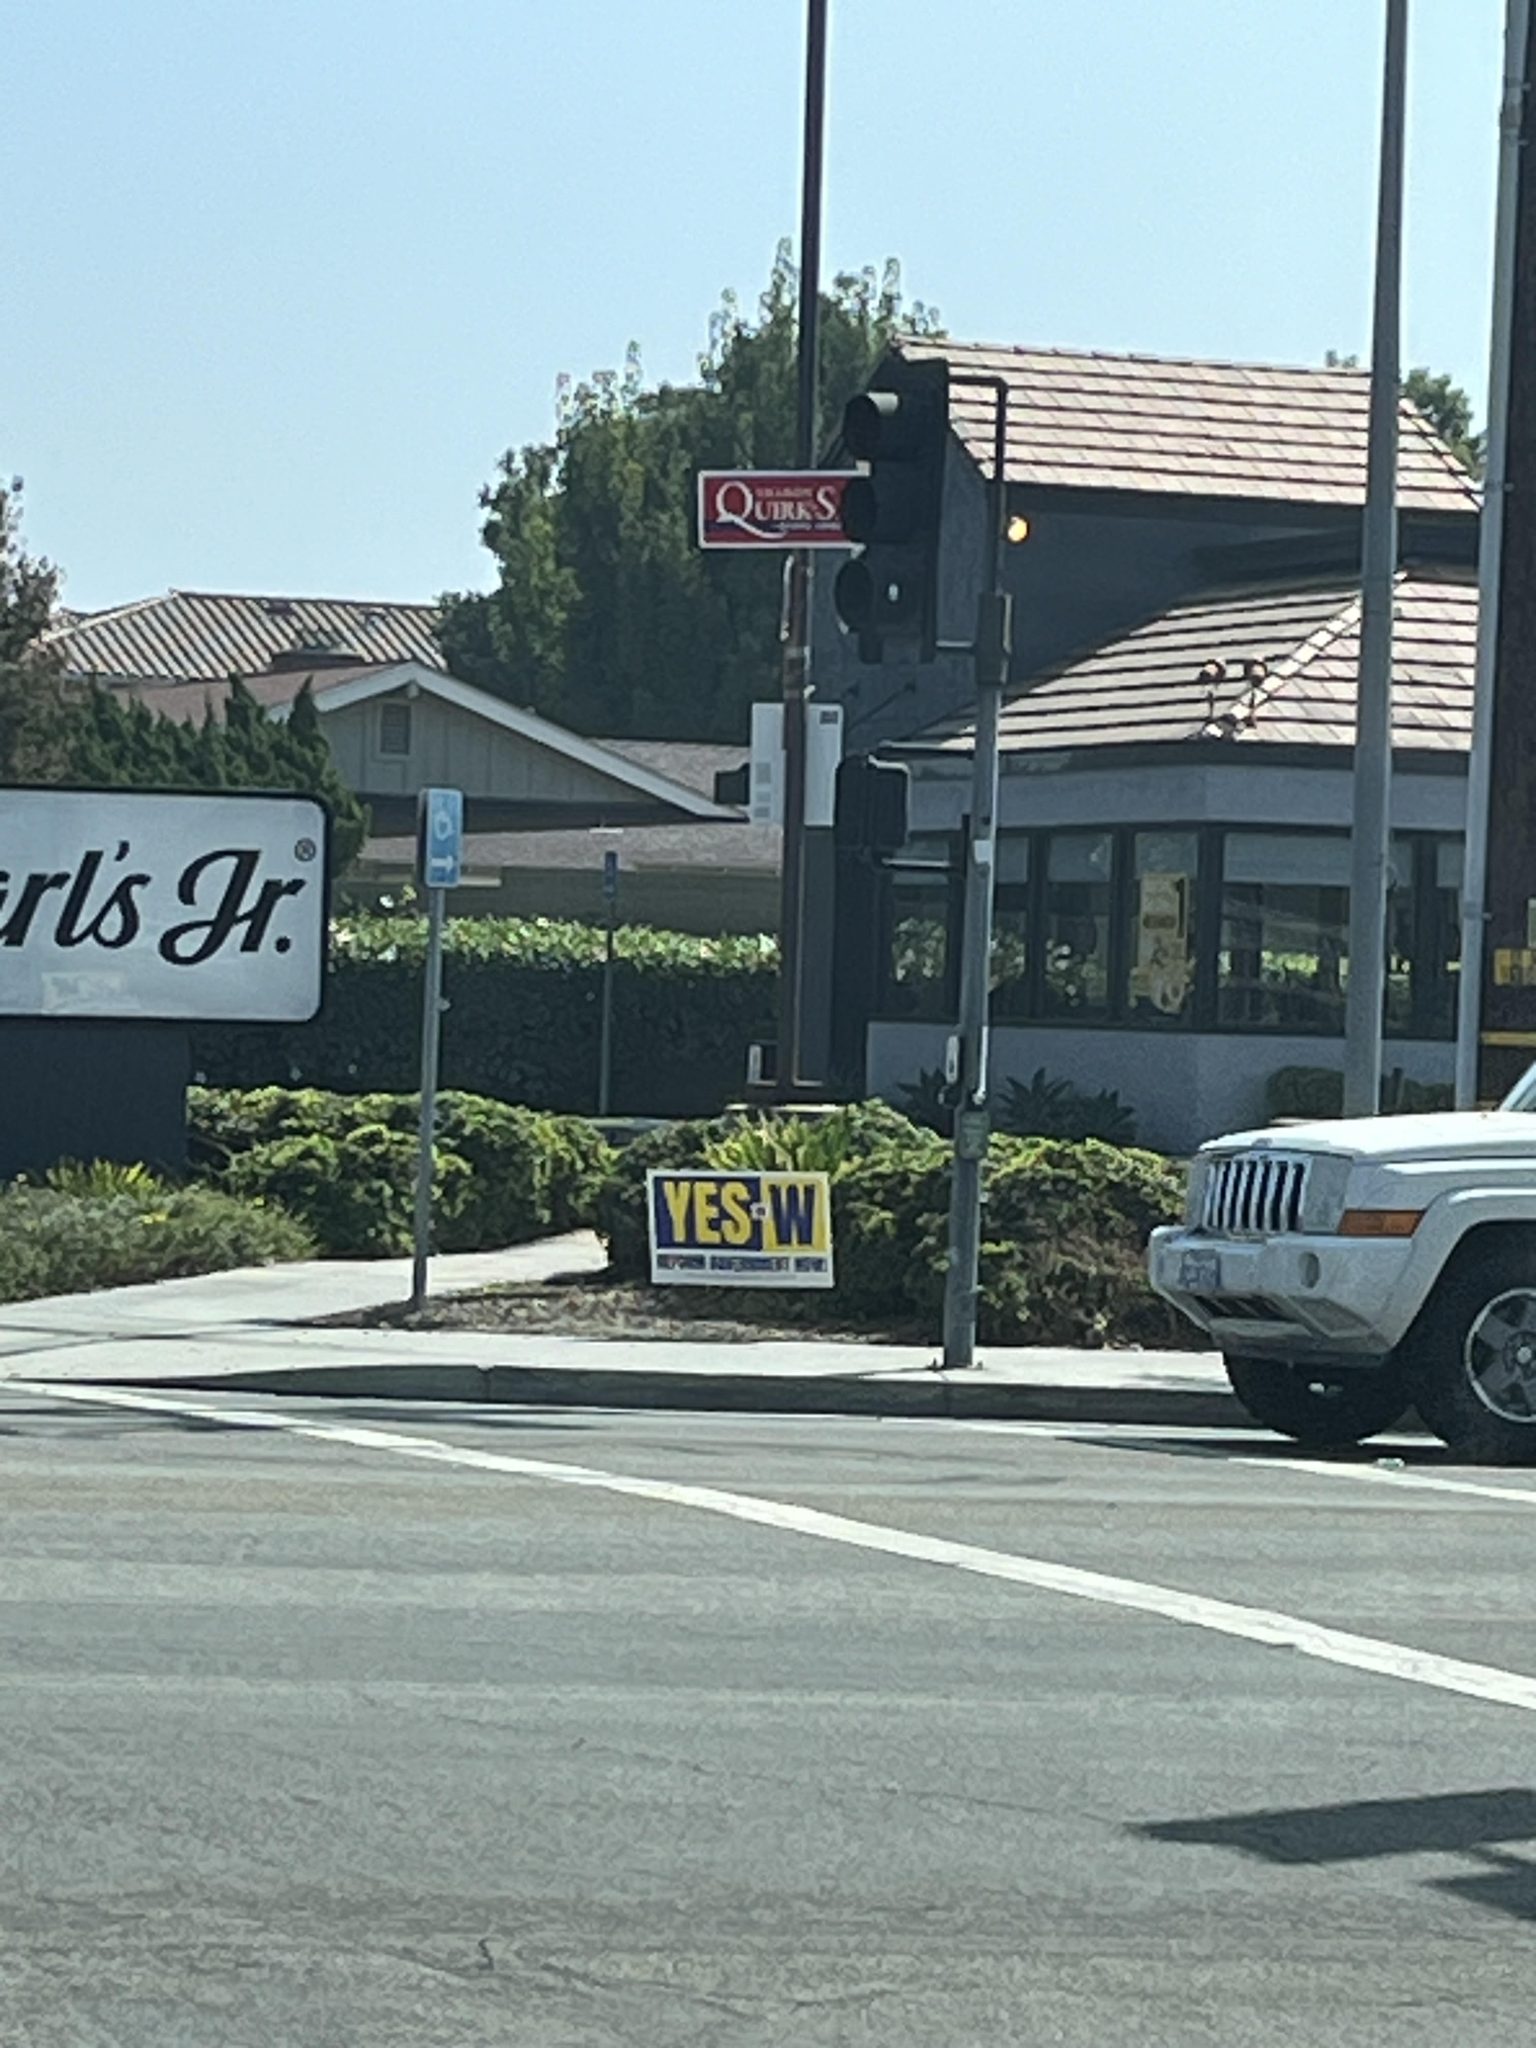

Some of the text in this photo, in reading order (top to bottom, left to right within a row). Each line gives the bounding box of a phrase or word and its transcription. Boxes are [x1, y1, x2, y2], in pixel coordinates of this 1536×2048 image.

[158, 849, 306, 966] Jr.
[663, 1181, 816, 1245] YES W
